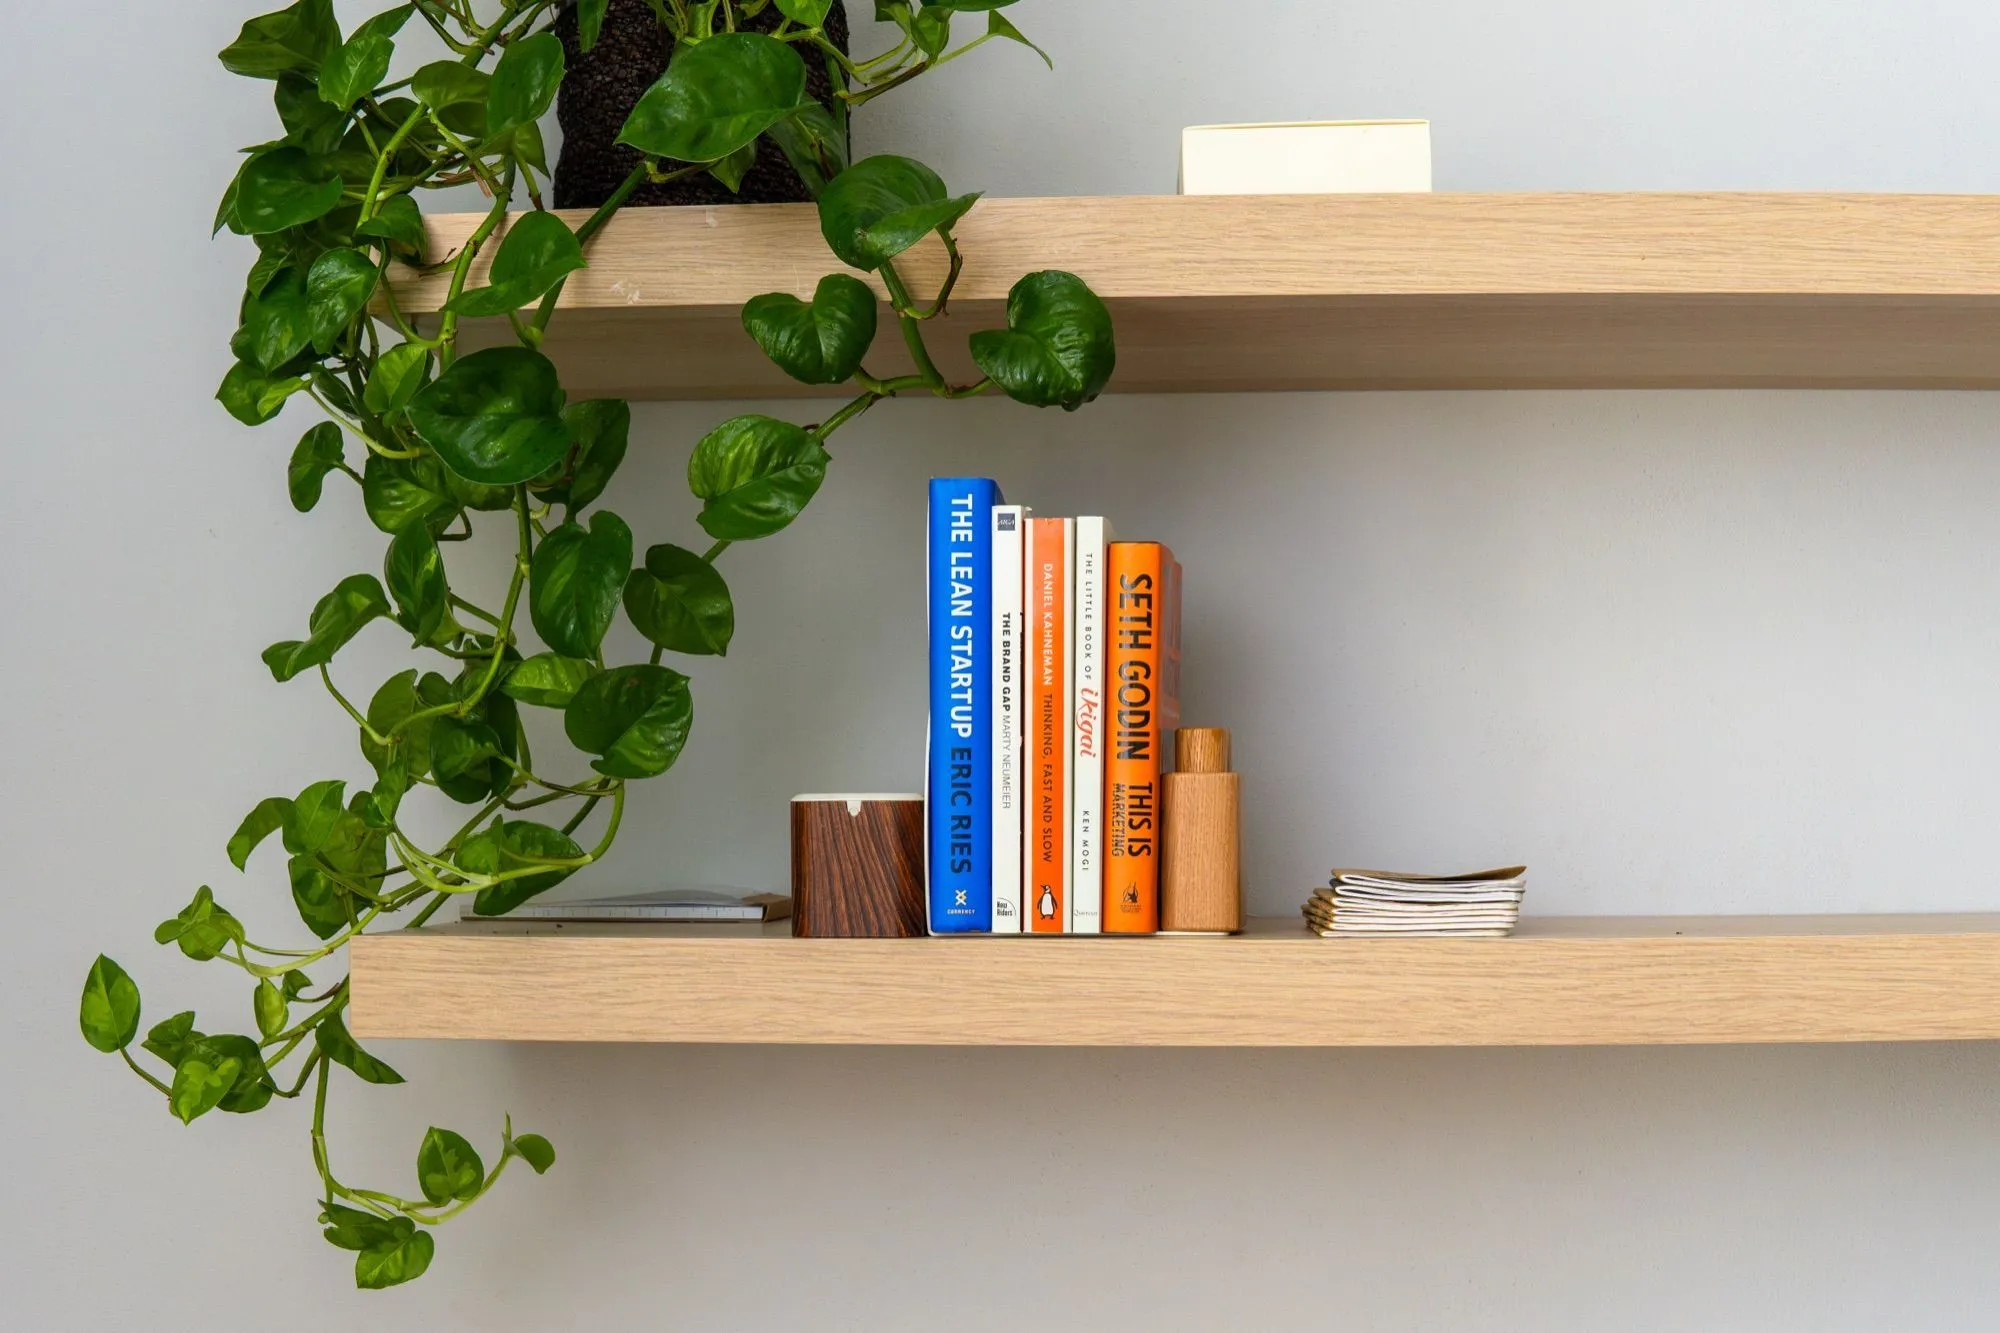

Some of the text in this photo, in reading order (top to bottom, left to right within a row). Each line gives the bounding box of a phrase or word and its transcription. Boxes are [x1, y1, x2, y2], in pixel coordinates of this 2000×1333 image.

[1085, 553, 1093, 575] THE
[950, 494, 973, 738] THE LEAN STARTUP
[1002, 612, 1011, 712] THE BRAND GAP
[1043, 563, 1053, 686] DANIEL KAHNEMAN
[1084, 666, 1092, 680] OF
[1116, 573, 1153, 761] SETH GODIN
[1002, 715, 1011, 809] MARTY NEUMEIER
[1076, 687, 1099, 758] ikigai
[950, 747, 972, 874] ERIC RIES
[1042, 694, 1053, 863] THINKING, FAST AND SLOW
[1112, 783, 1126, 857] MARKETING
[1127, 782, 1153, 857] THIS IS
